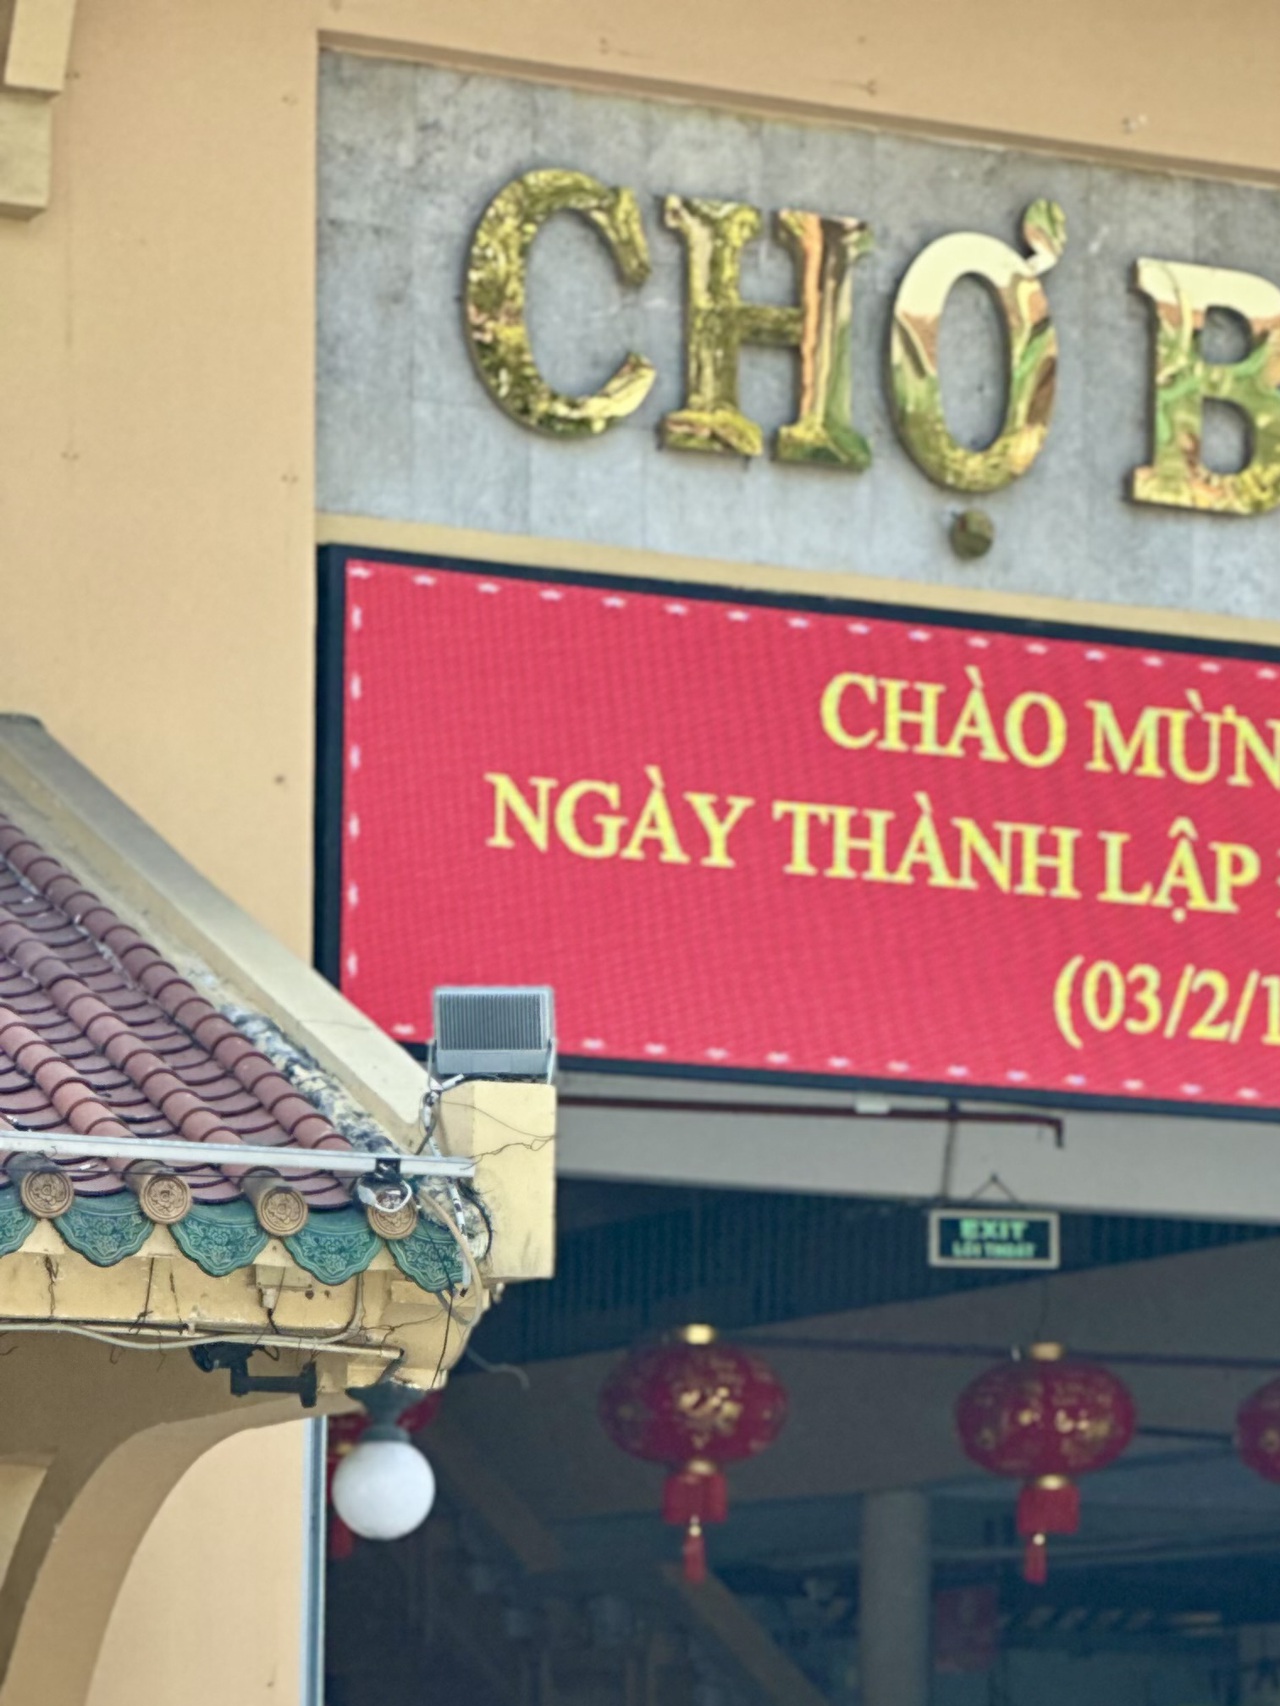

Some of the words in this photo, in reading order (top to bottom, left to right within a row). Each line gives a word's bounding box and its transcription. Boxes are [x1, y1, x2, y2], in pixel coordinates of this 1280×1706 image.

[465, 169, 1066, 560] CHỢ
[820, 665, 1067, 768] CHÀO
[484, 765, 754, 868] NGÀY
[772, 791, 1081, 899] THÀNH
[1098, 817, 1260, 922] LẬP
[960, 1218, 1028, 1240] EXIT
